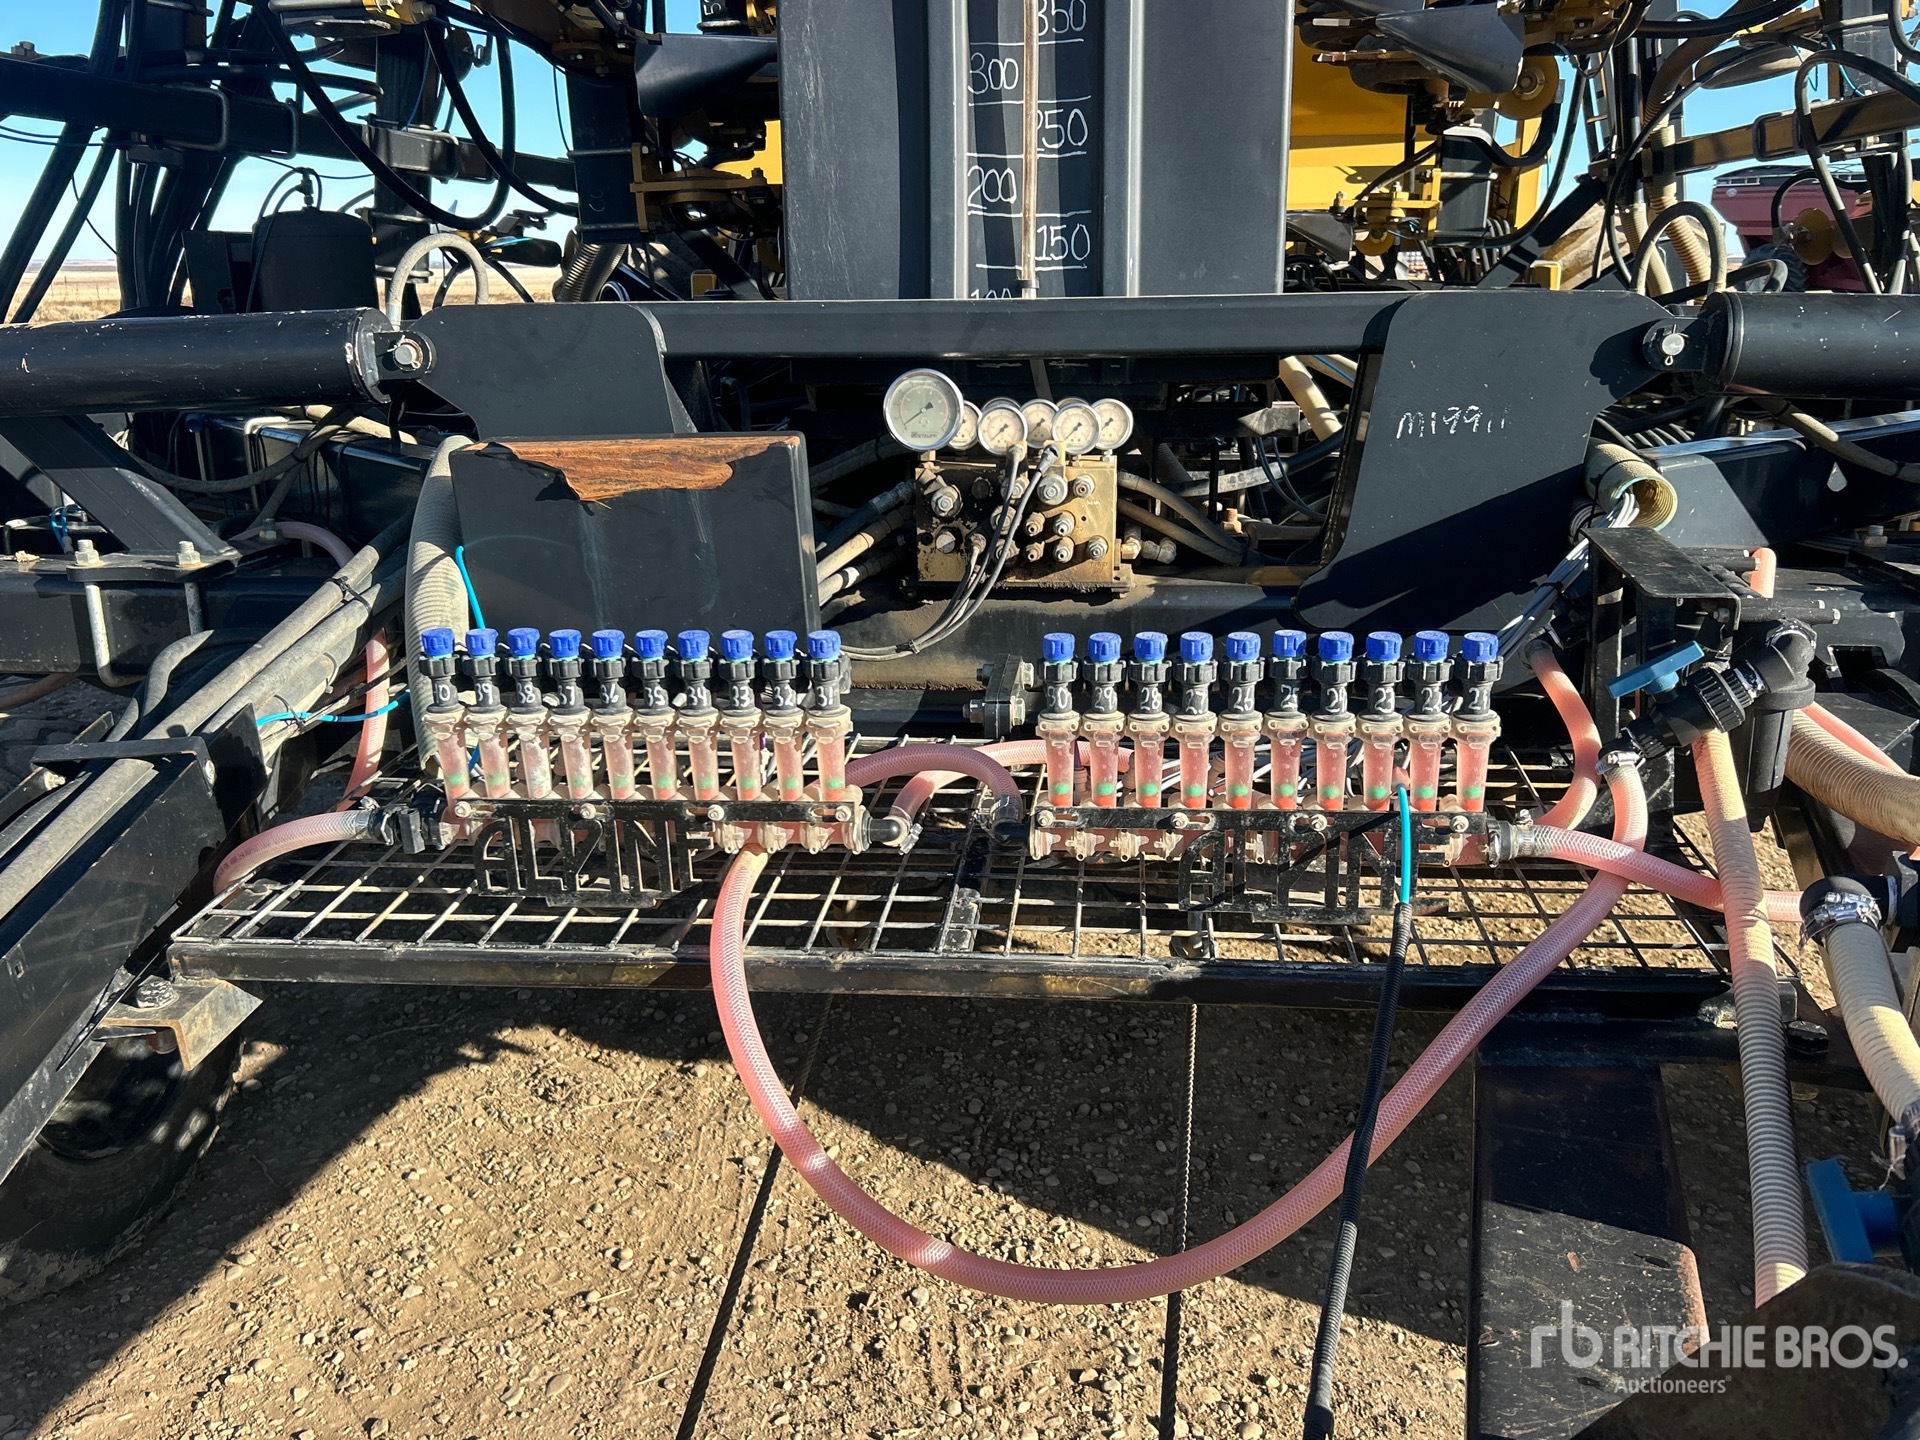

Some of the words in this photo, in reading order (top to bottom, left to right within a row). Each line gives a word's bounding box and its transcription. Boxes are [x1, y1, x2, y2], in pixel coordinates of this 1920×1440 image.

[967, 52, 1019, 94] 300
[967, 165, 1017, 210] 200
[1035, 223, 1091, 261] 150
[475, 682, 493, 705] 39
[516, 682, 535, 704] 38
[558, 685, 575, 706] 37
[601, 684, 619, 704] 36
[645, 685, 666, 706] 35
[687, 685, 708, 707] 34
[732, 685, 750, 708] 33
[774, 684, 794, 707] 32
[816, 685, 834, 707] 31
[1047, 685, 1070, 709] 30
[1094, 685, 1114, 711] 29
[1140, 686, 1162, 711] 28
[1233, 686, 1255, 711] 26
[1374, 687, 1395, 713] 23
